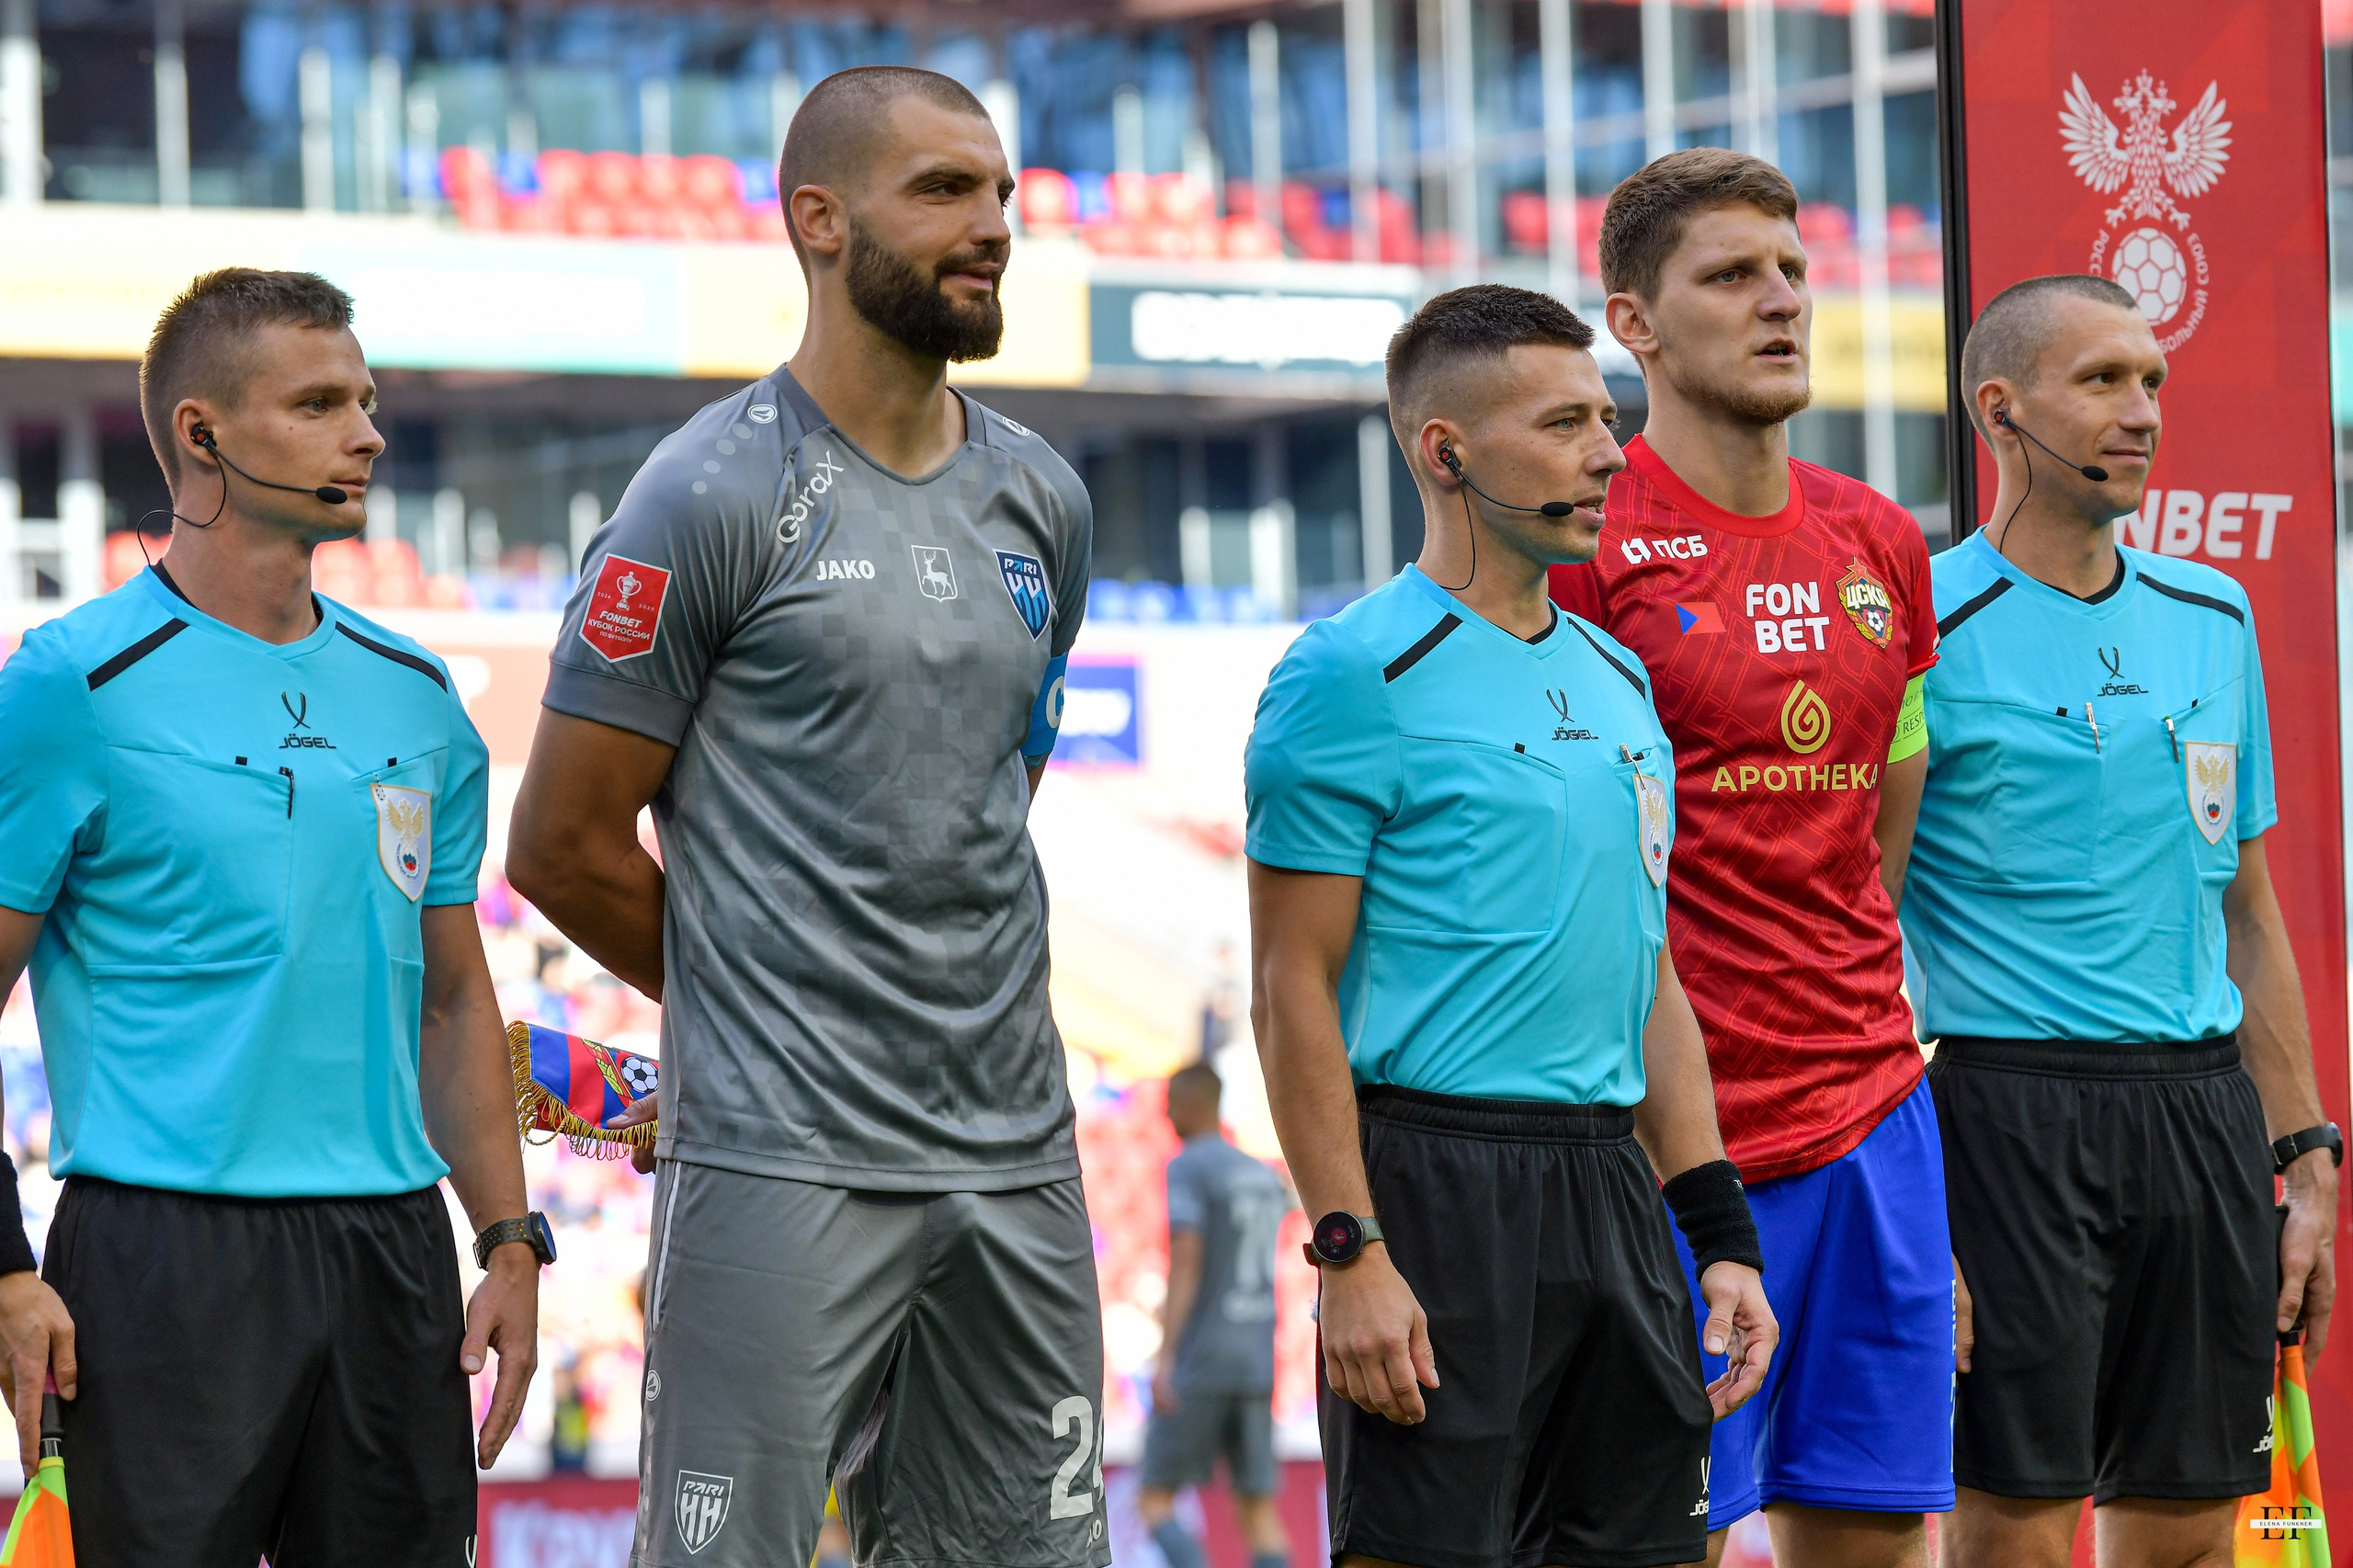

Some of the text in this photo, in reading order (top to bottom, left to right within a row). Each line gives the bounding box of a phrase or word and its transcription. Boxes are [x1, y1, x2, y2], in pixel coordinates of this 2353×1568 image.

[2158, 233, 2210, 355] БОЛЬНЫЙ СОЮЗ
[2113, 489, 2293, 560] NBET
[1651, 535, 1708, 560] ПСБ
[816, 559, 875, 581] JAKO
[1746, 581, 1821, 617] FON
[1846, 583, 1892, 609] ЦСКА
[587, 619, 651, 641] КУБОК РОССИИ
[599, 610, 642, 629] FONBET
[1755, 617, 1830, 653] BET
[2097, 683, 2149, 697] JÖGEL
[1045, 676, 1065, 729] C
[278, 733, 337, 749] JÖGEL
[1551, 727, 1599, 741] JÖGEL
[1711, 763, 1879, 791] APOTHEKA
[683, 1480, 725, 1496] PARI
[1688, 1498, 1710, 1517] JÖG
